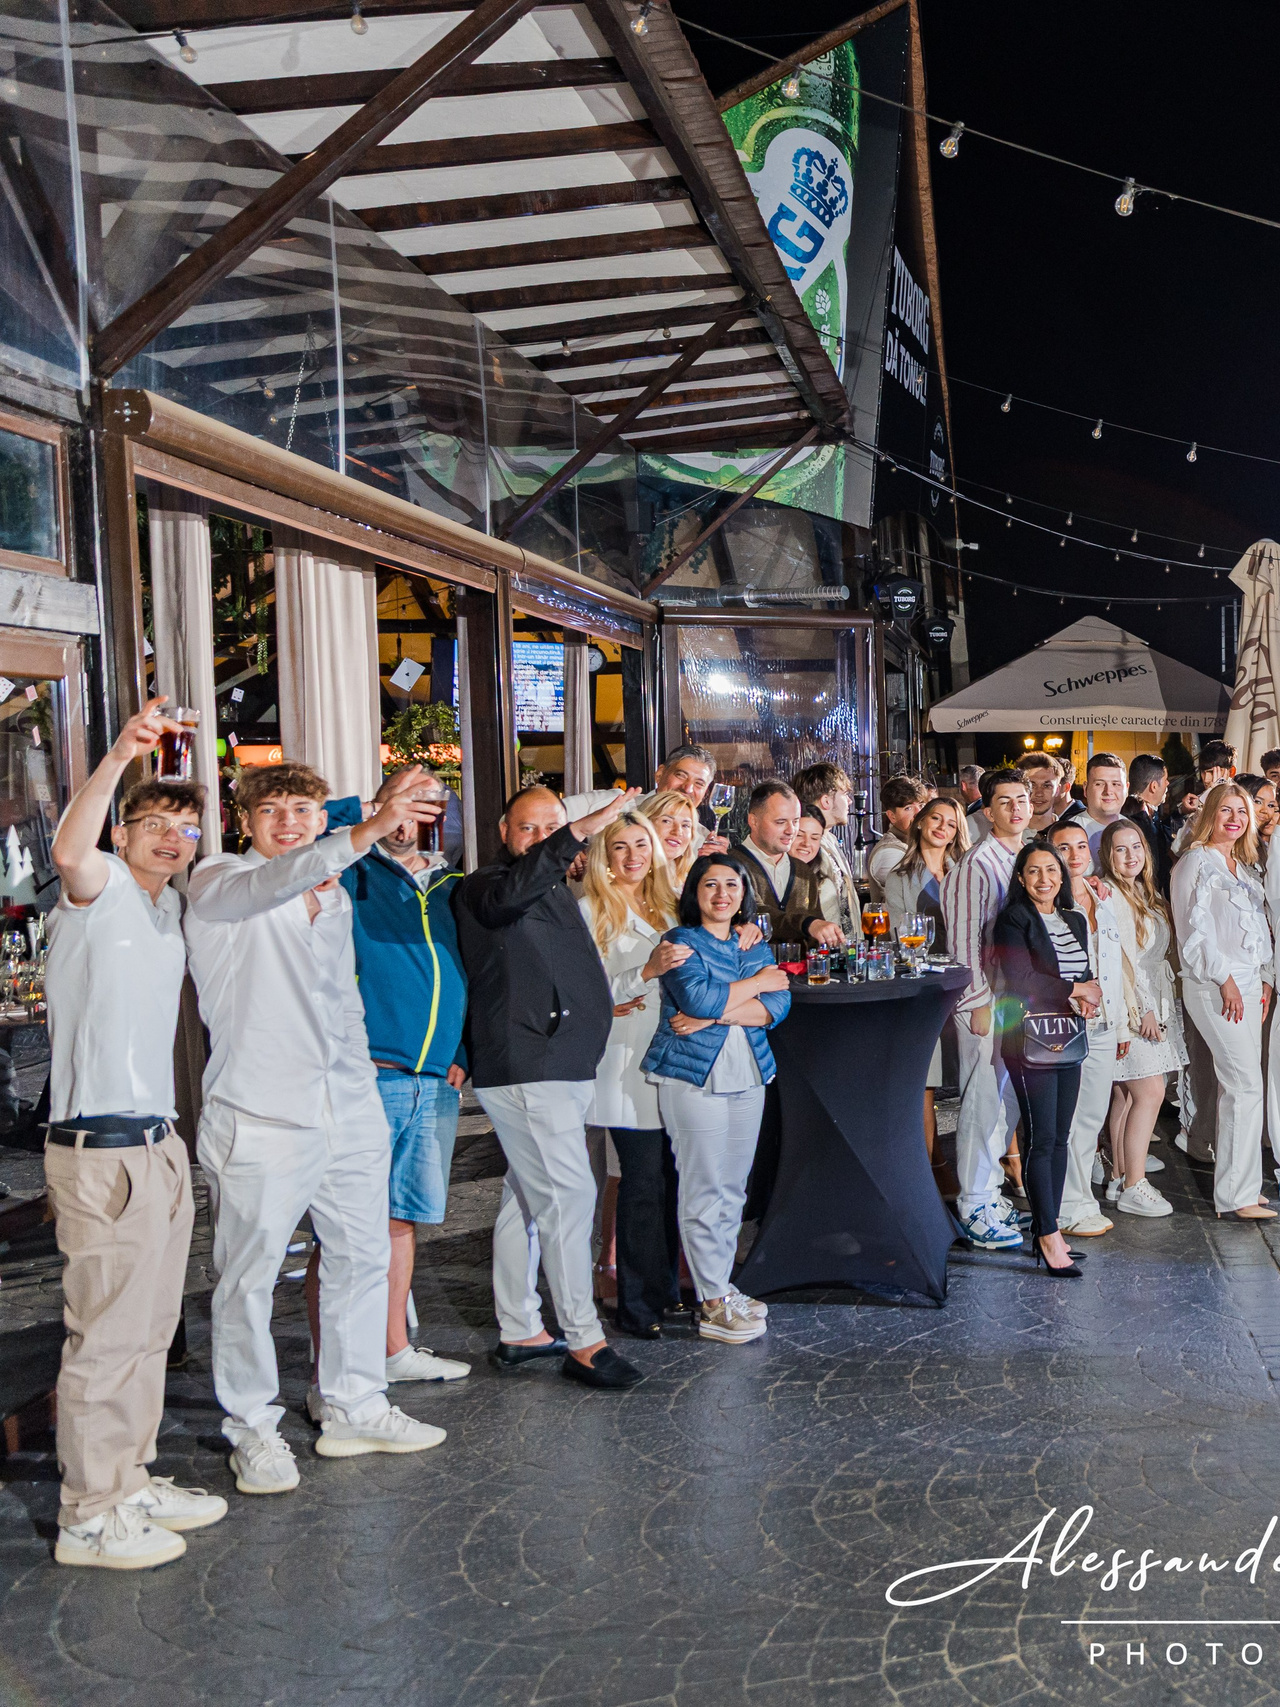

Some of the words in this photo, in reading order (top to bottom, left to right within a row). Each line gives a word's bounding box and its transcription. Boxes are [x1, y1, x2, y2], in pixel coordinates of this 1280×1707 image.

[891, 245, 930, 355] TUBORG
[885, 327, 900, 380] DĂ
[1043, 664, 1148, 697] Schweppes
[957, 710, 989, 730] Schweppes
[1040, 713, 1118, 727] Construiește
[1121, 715, 1178, 726] caractere
[1180, 715, 1200, 727] din
[1029, 1017, 1080, 1036] VLTN
